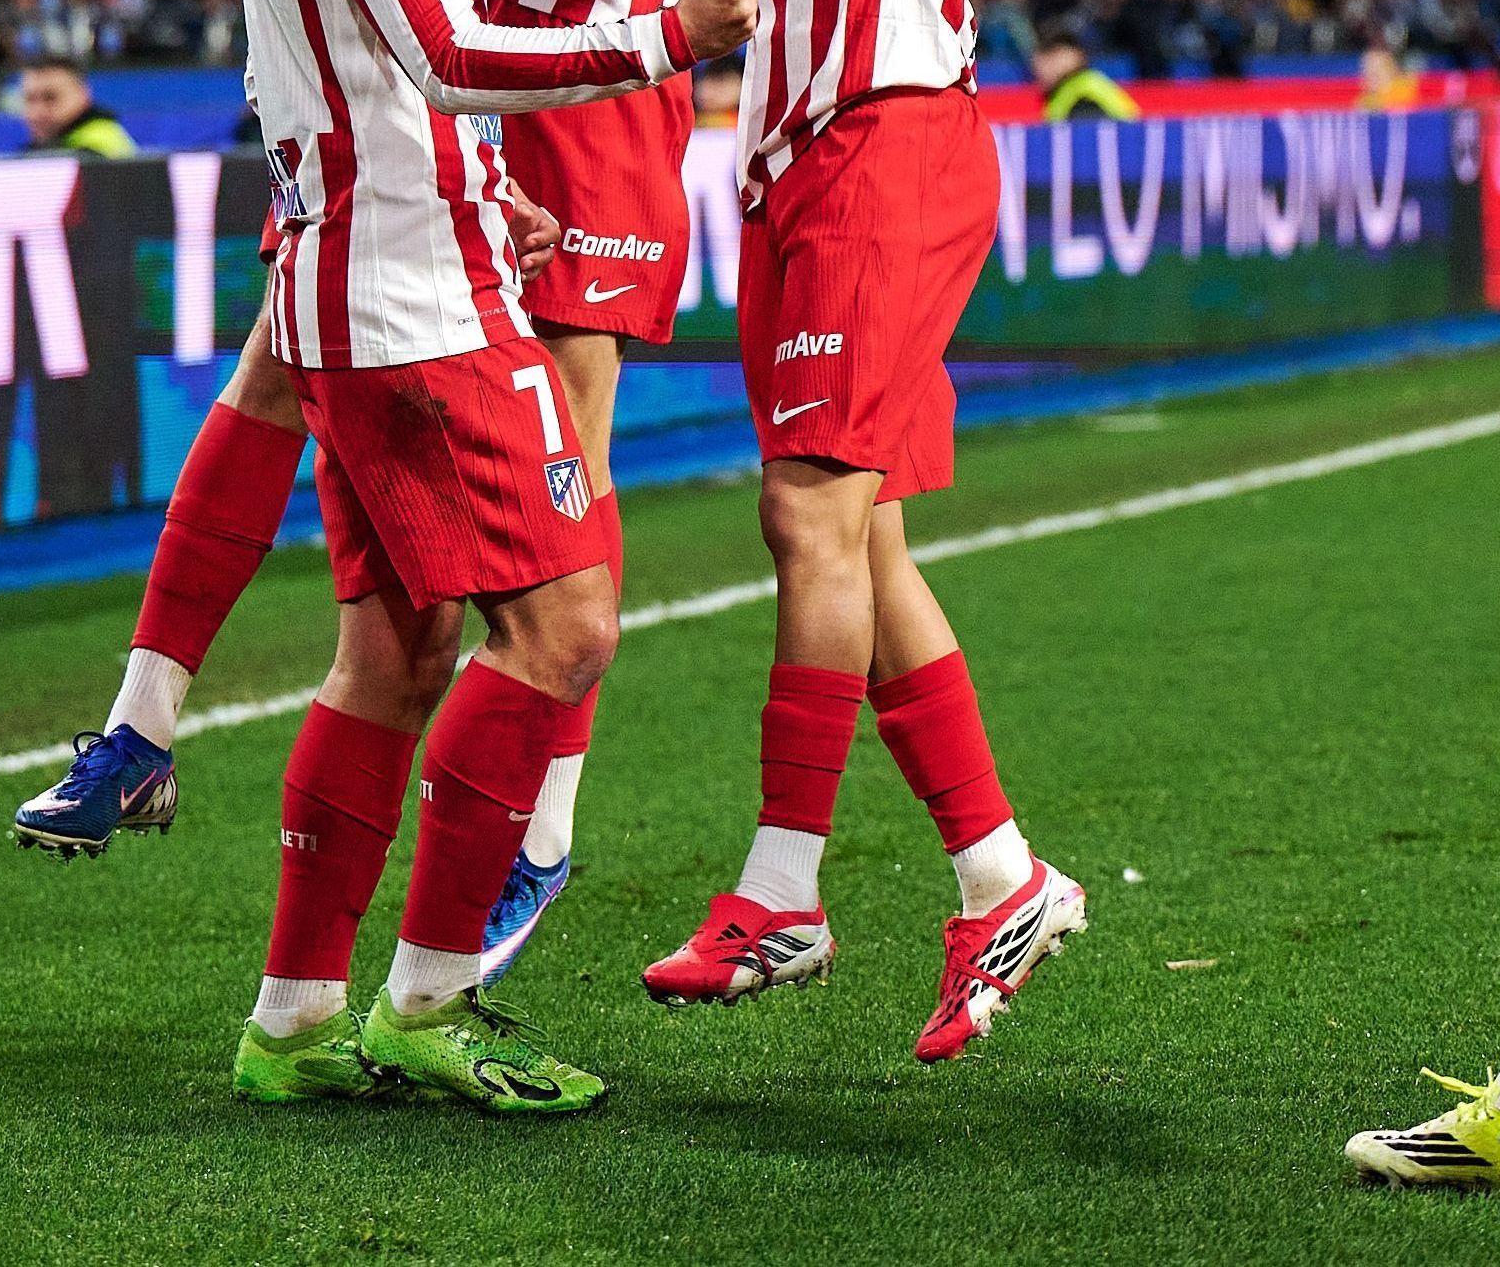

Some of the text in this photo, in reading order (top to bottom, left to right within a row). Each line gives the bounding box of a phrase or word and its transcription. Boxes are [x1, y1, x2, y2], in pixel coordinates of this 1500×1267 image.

[562, 227, 665, 262] ComAve
[774, 331, 844, 367] mAve
[512, 364, 564, 455] 7
